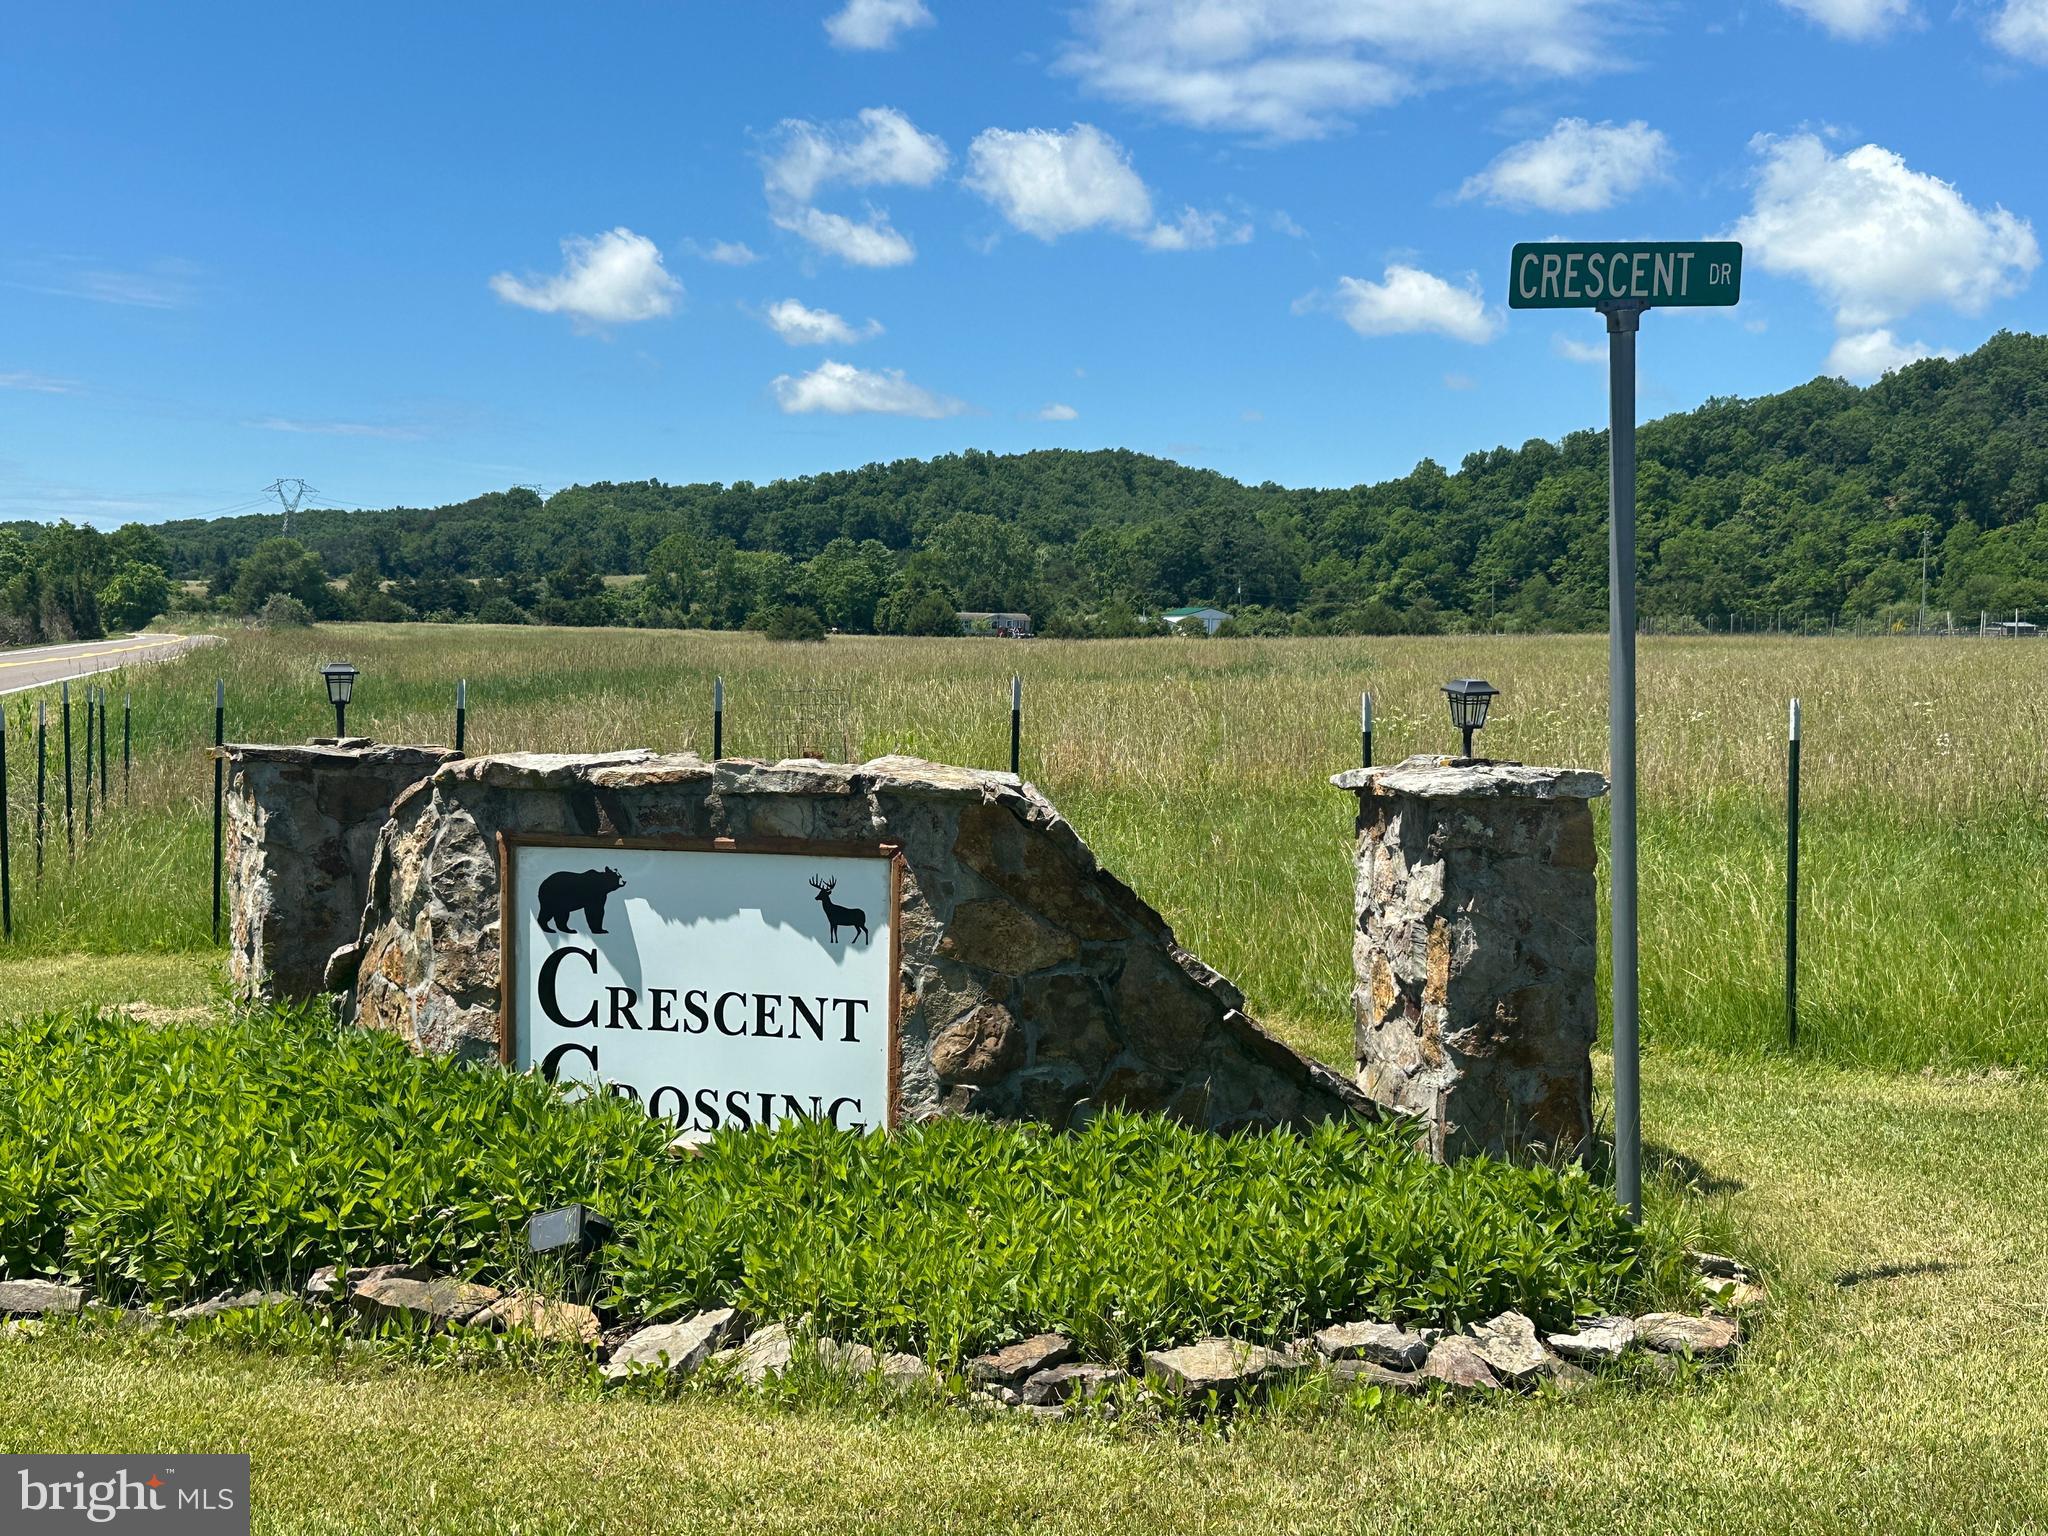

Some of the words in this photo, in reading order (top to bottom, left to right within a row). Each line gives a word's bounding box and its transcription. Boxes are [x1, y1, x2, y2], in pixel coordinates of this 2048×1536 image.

[1518, 252, 1695, 299] CRESCENT
[1709, 263, 1731, 285] DR
[537, 946, 869, 1043] CRESCENT
